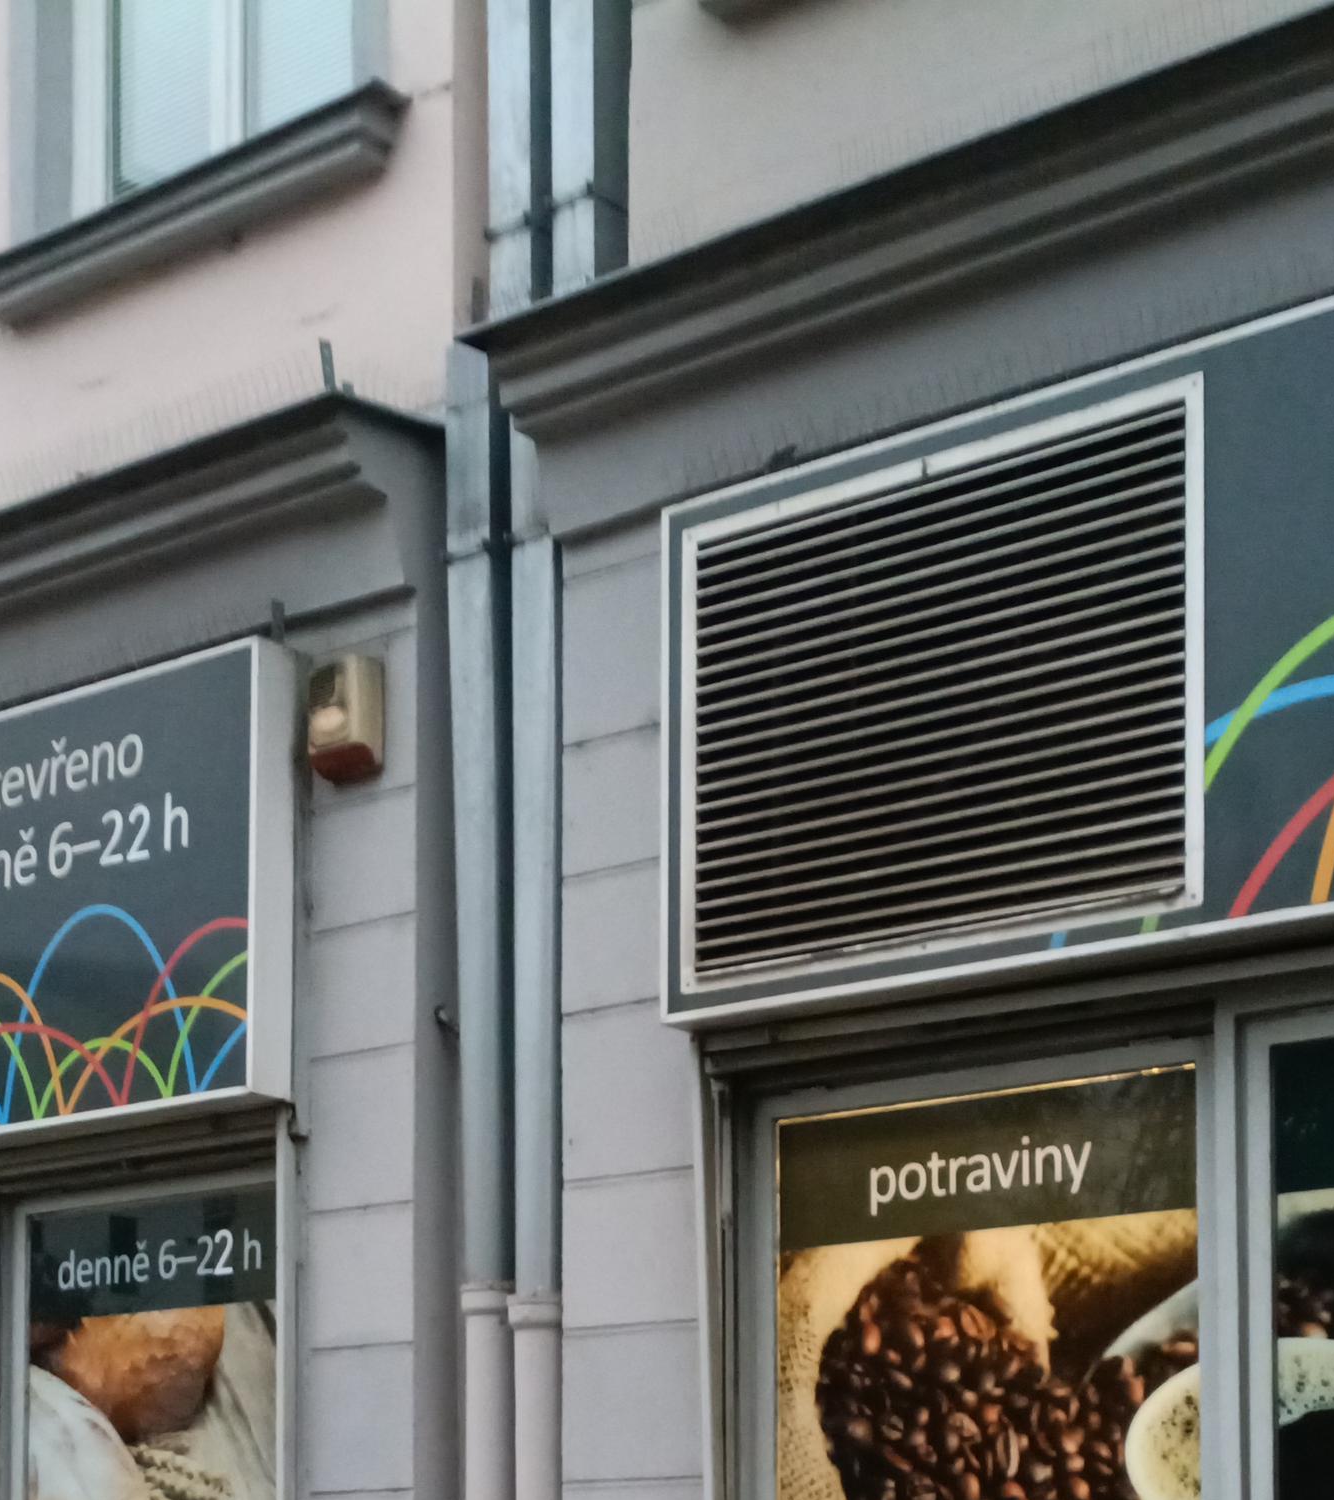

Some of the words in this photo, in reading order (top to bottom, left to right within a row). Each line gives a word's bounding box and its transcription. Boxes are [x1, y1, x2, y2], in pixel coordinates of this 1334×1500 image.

[164, 792, 190, 850] h
[868, 1135, 1093, 1216] potraviny
[58, 1240, 150, 1290] denně
[244, 1228, 262, 1271] h
